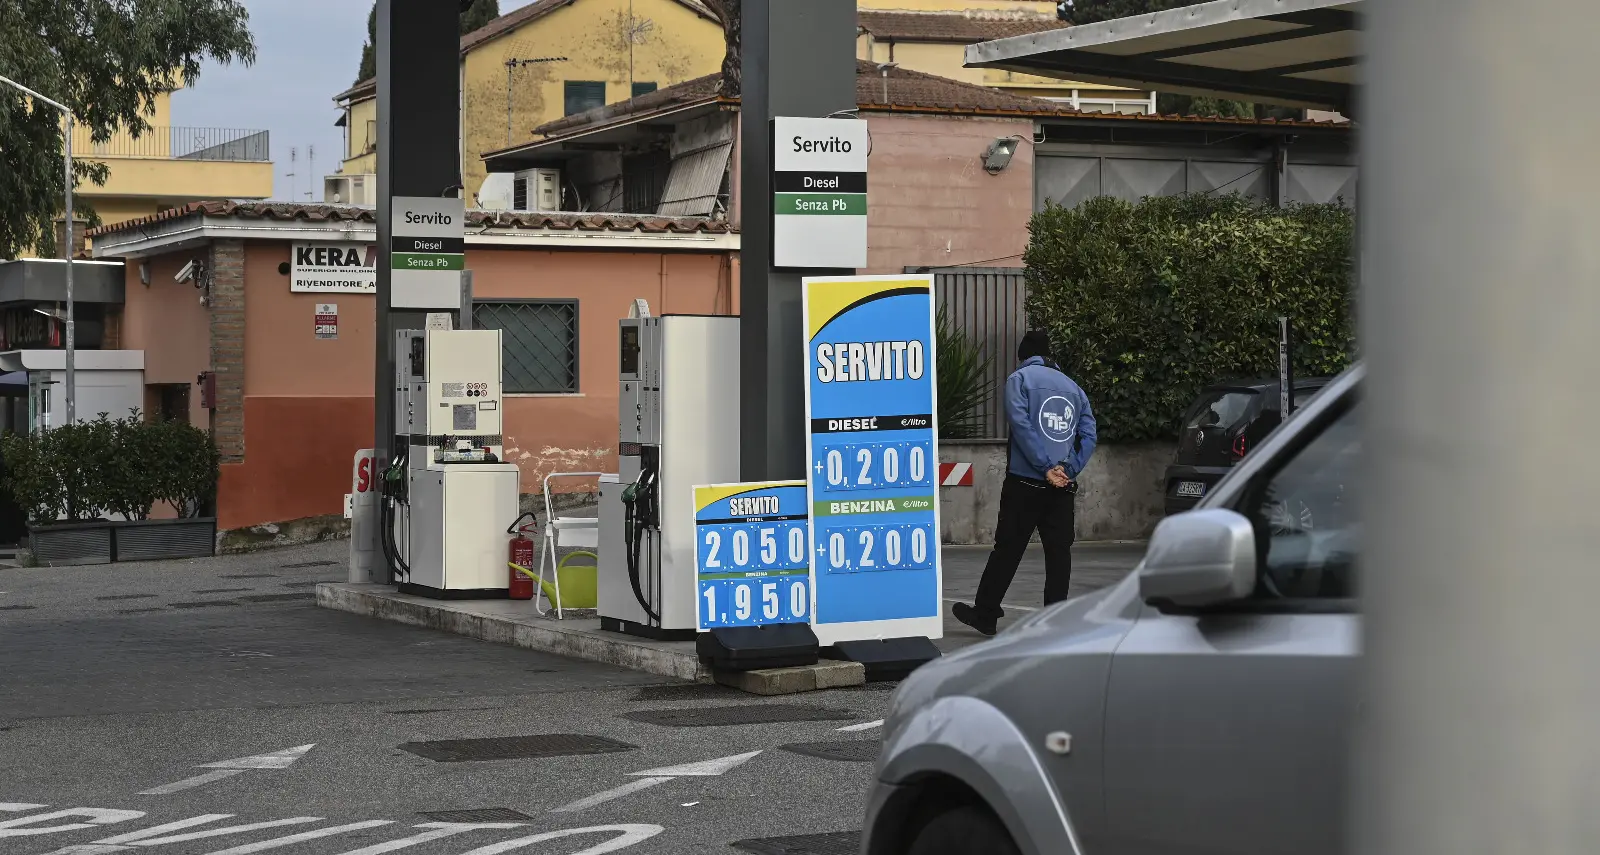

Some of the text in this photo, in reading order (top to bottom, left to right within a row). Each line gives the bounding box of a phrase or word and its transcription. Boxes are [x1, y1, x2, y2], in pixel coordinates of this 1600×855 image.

[793, 136, 852, 153] Servito
[804, 176, 839, 188] Diesel
[796, 199, 847, 211] Senza Pb
[405, 211, 452, 225] Servito
[414, 241, 442, 250] Diesel
[407, 258, 448, 267] Senza Pb
[296, 280, 363, 288] RIVENDITORE
[817, 340, 924, 383] SERVITO
[828, 418, 878, 431] DIESEL
[729, 495, 779, 516] SERVITO
[830, 500, 896, 514] BENZINA
[703, 581, 806, 622] 1,950
